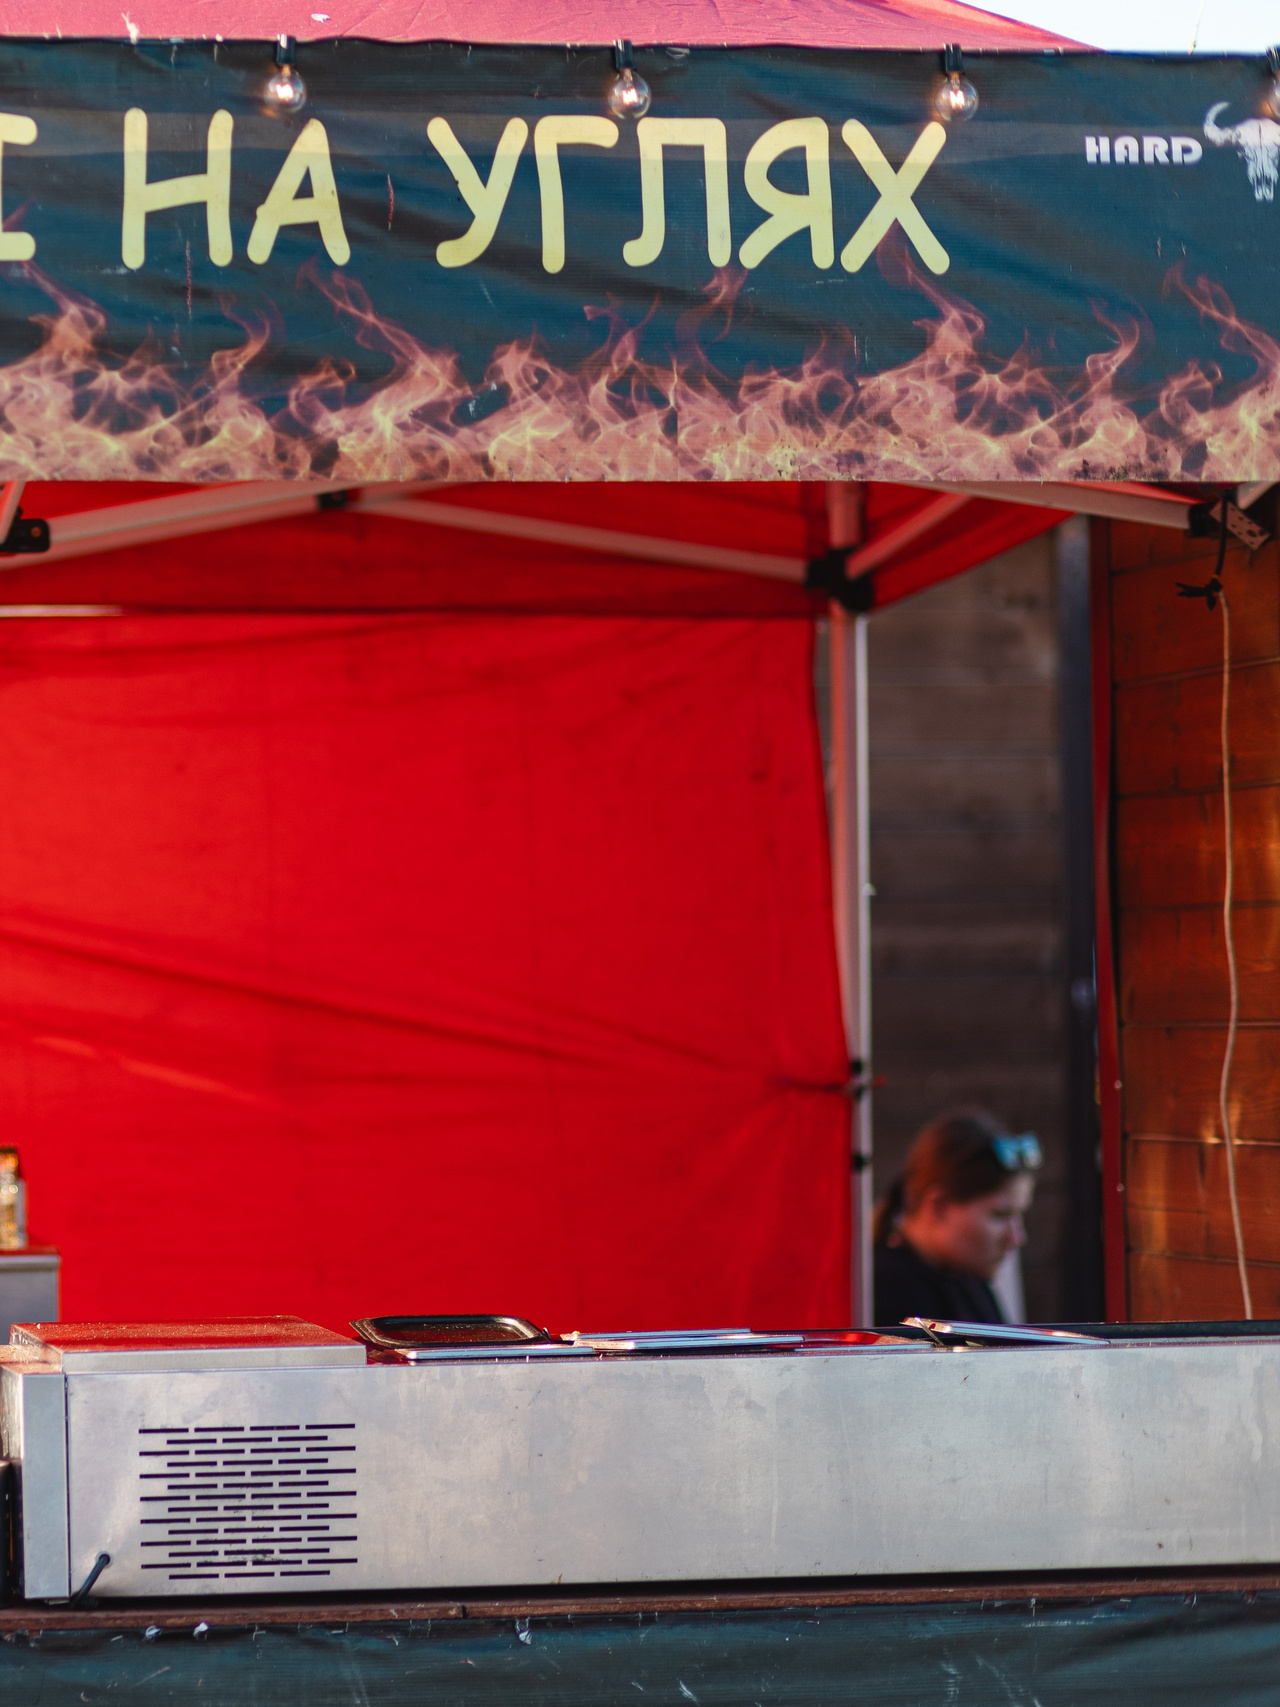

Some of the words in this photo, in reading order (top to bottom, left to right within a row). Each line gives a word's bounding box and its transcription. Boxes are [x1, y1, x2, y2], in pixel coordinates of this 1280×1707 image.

[121, 107, 351, 270] НА
[426, 115, 950, 275] УГЛЯХ
[1084, 135, 1204, 165] HARD
